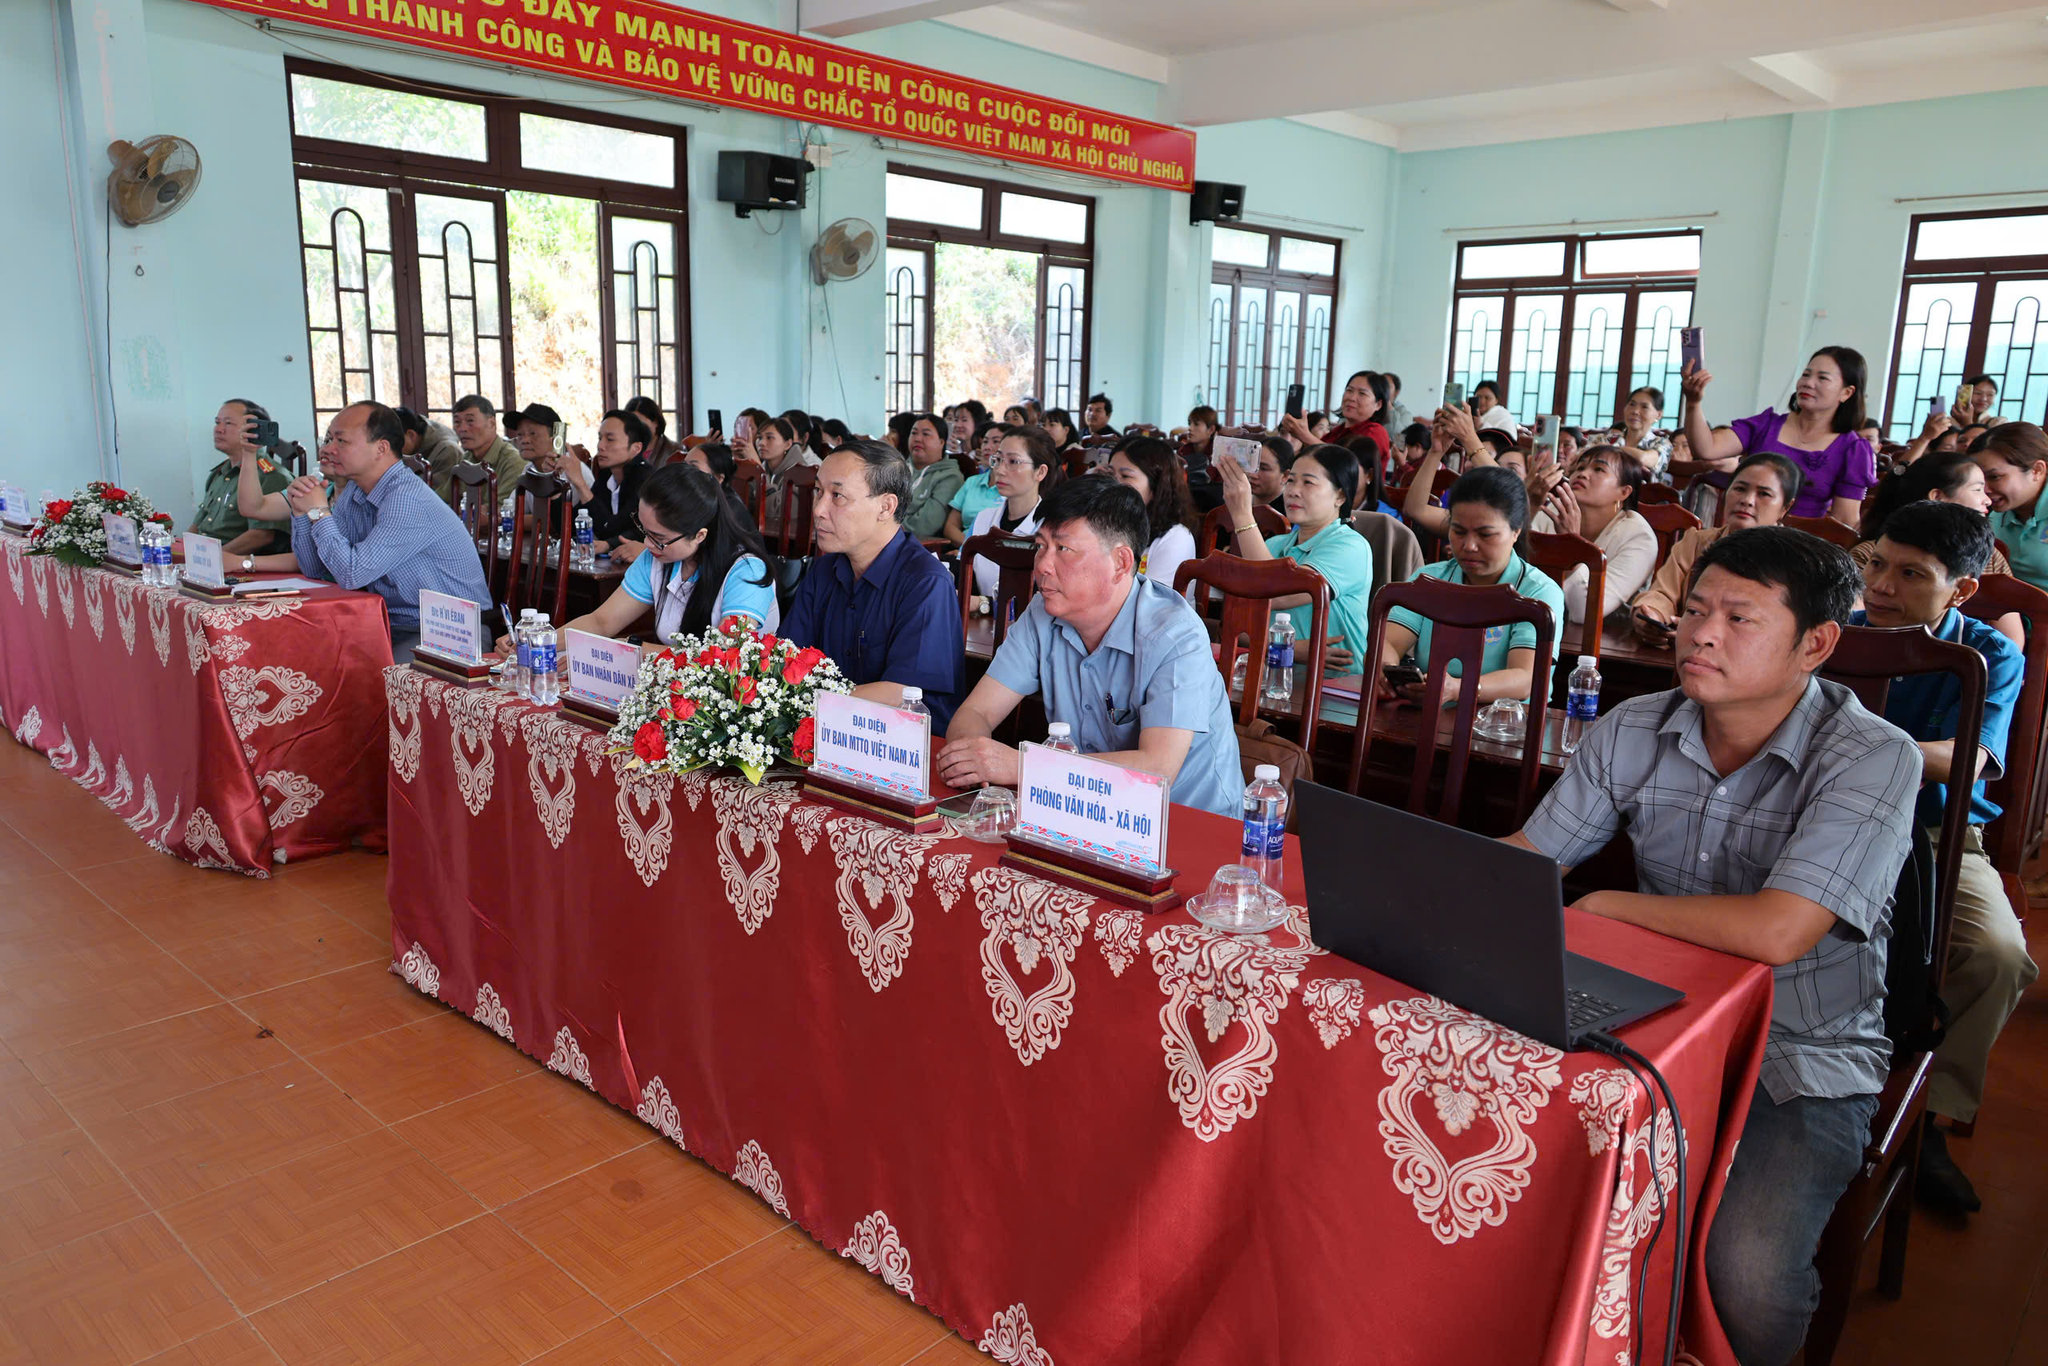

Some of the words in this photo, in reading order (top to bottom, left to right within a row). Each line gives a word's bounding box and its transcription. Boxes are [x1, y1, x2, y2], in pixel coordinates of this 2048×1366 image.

[477, 17, 565, 58] CÔNG
[575, 37, 614, 69] VÀ
[624, 48, 679, 81] BẢO
[688, 62, 720, 94] VỆ
[729, 71, 795, 105] VỮNG
[804, 88, 864, 119] CHẮC
[870, 98, 897, 126] TỔ
[904, 110, 957, 138] QUỐC
[964, 122, 1003, 148] VIỆT
[1008, 132, 1046, 156] NAM
[1051, 139, 1071, 161] XÃ
[1077, 145, 1103, 169] HỘI
[1108, 151, 1138, 173] CHỦ
[1143, 160, 1184, 181] NGHĨA
[615, 11, 720, 56] MẠNH
[732, 38, 814, 77] TOÀN
[826, 61, 890, 94] DIỆN
[901, 79, 970, 112] CÔNG
[979, 97, 1041, 127] CUỘC
[1048, 110, 1084, 137] ĐỔI
[1092, 123, 1130, 146] MỚI
[572, 655, 580, 673] ỦY
[581, 662, 594, 677] BAN
[594, 666, 612, 683] NHÂN
[613, 670, 626, 687] DÂN
[821, 722, 830, 742] ỦY
[832, 730, 847, 748] BAN
[849, 735, 869, 756] MTTQ
[871, 739, 887, 761] VIỆT
[889, 746, 907, 765] NAM
[909, 750, 920, 768] XÃ
[852, 715, 866, 730] ĐẠI
[868, 719, 886, 735] DIỆN
[1068, 772, 1085, 790] ĐẠI
[1088, 777, 1112, 796] DIỆN
[1030, 785, 1062, 811] PHÒNG
[1065, 794, 1084, 817] VĂN
[1086, 800, 1106, 823] HÓA
[1116, 809, 1130, 830] XÃ
[1133, 813, 1151, 839] HỘI
